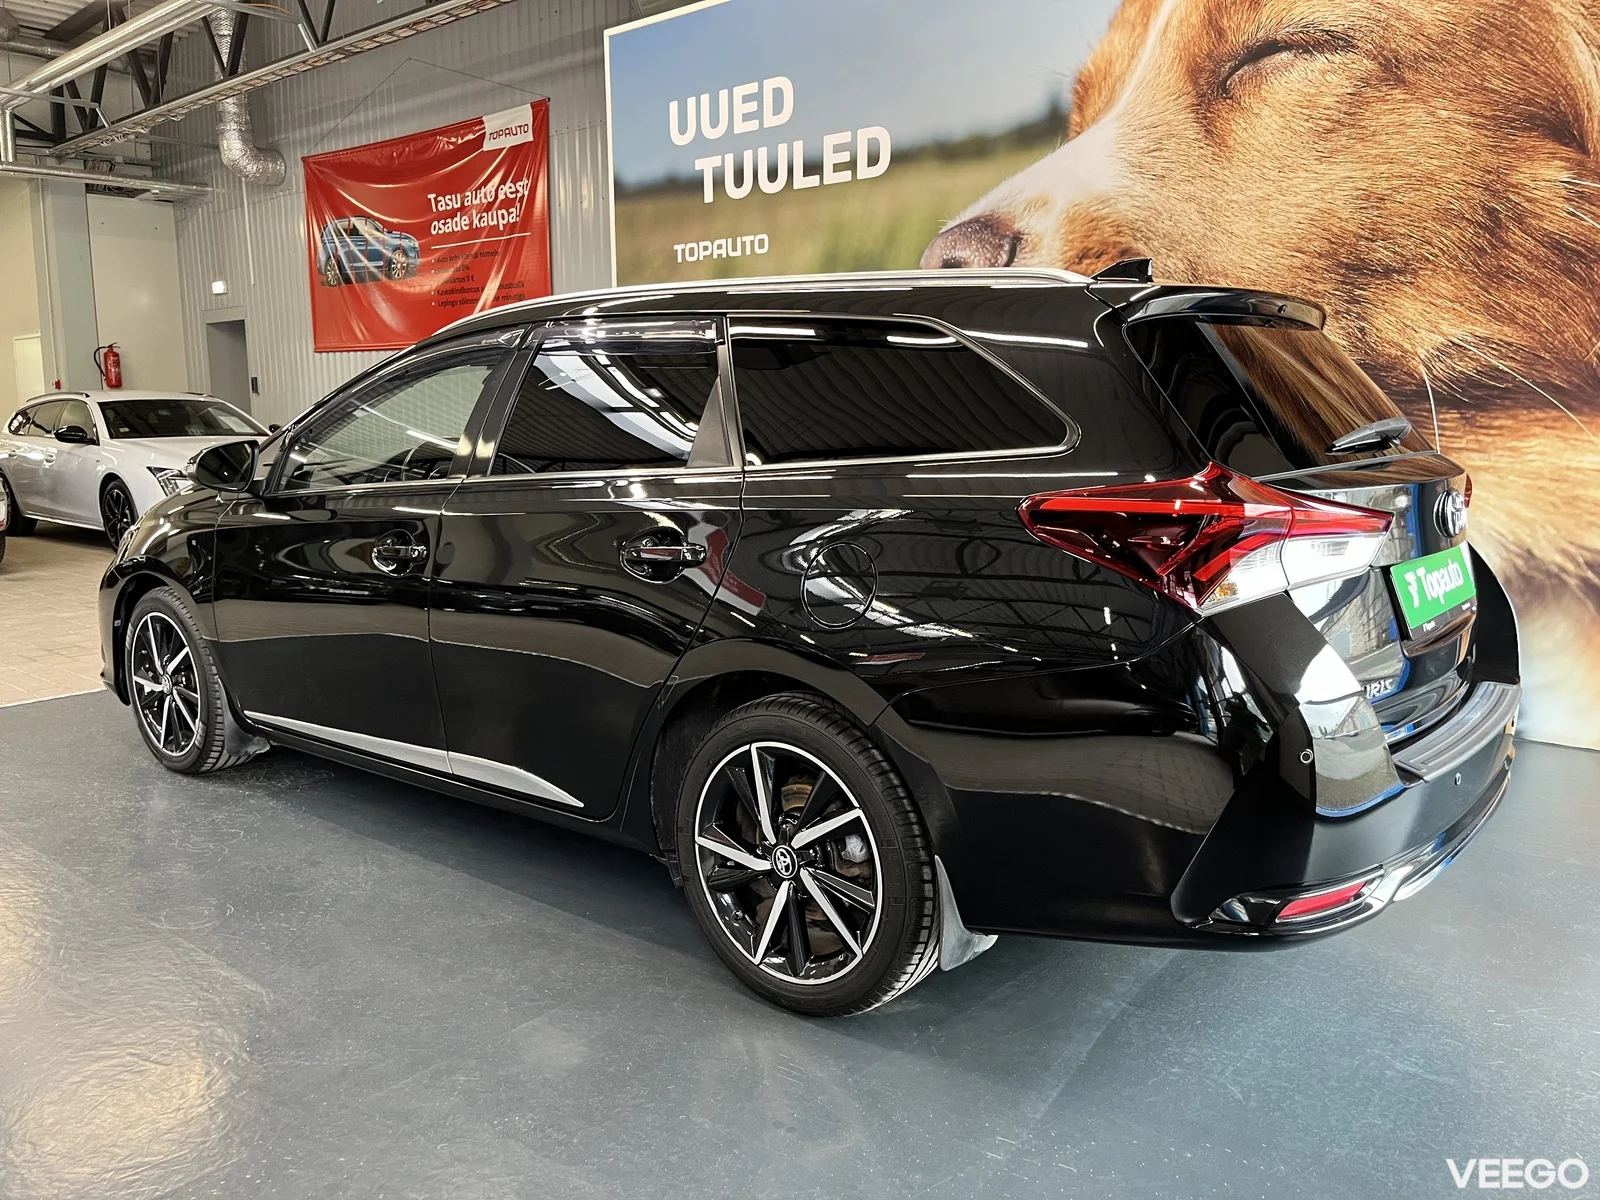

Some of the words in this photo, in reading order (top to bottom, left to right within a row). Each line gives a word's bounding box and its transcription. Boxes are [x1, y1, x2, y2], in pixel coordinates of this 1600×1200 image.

[669, 76, 794, 146] UUED
[488, 123, 529, 141] TOPAUTO
[695, 125, 891, 203] TUULED
[427, 193, 461, 212] Tasu
[464, 185, 495, 207] auto
[498, 178, 529, 200] eest
[430, 212, 470, 235] osade
[472, 202, 520, 231] kaupa!
[673, 233, 769, 263] TOPAUTO
[1416, 559, 1464, 604] Topauto
